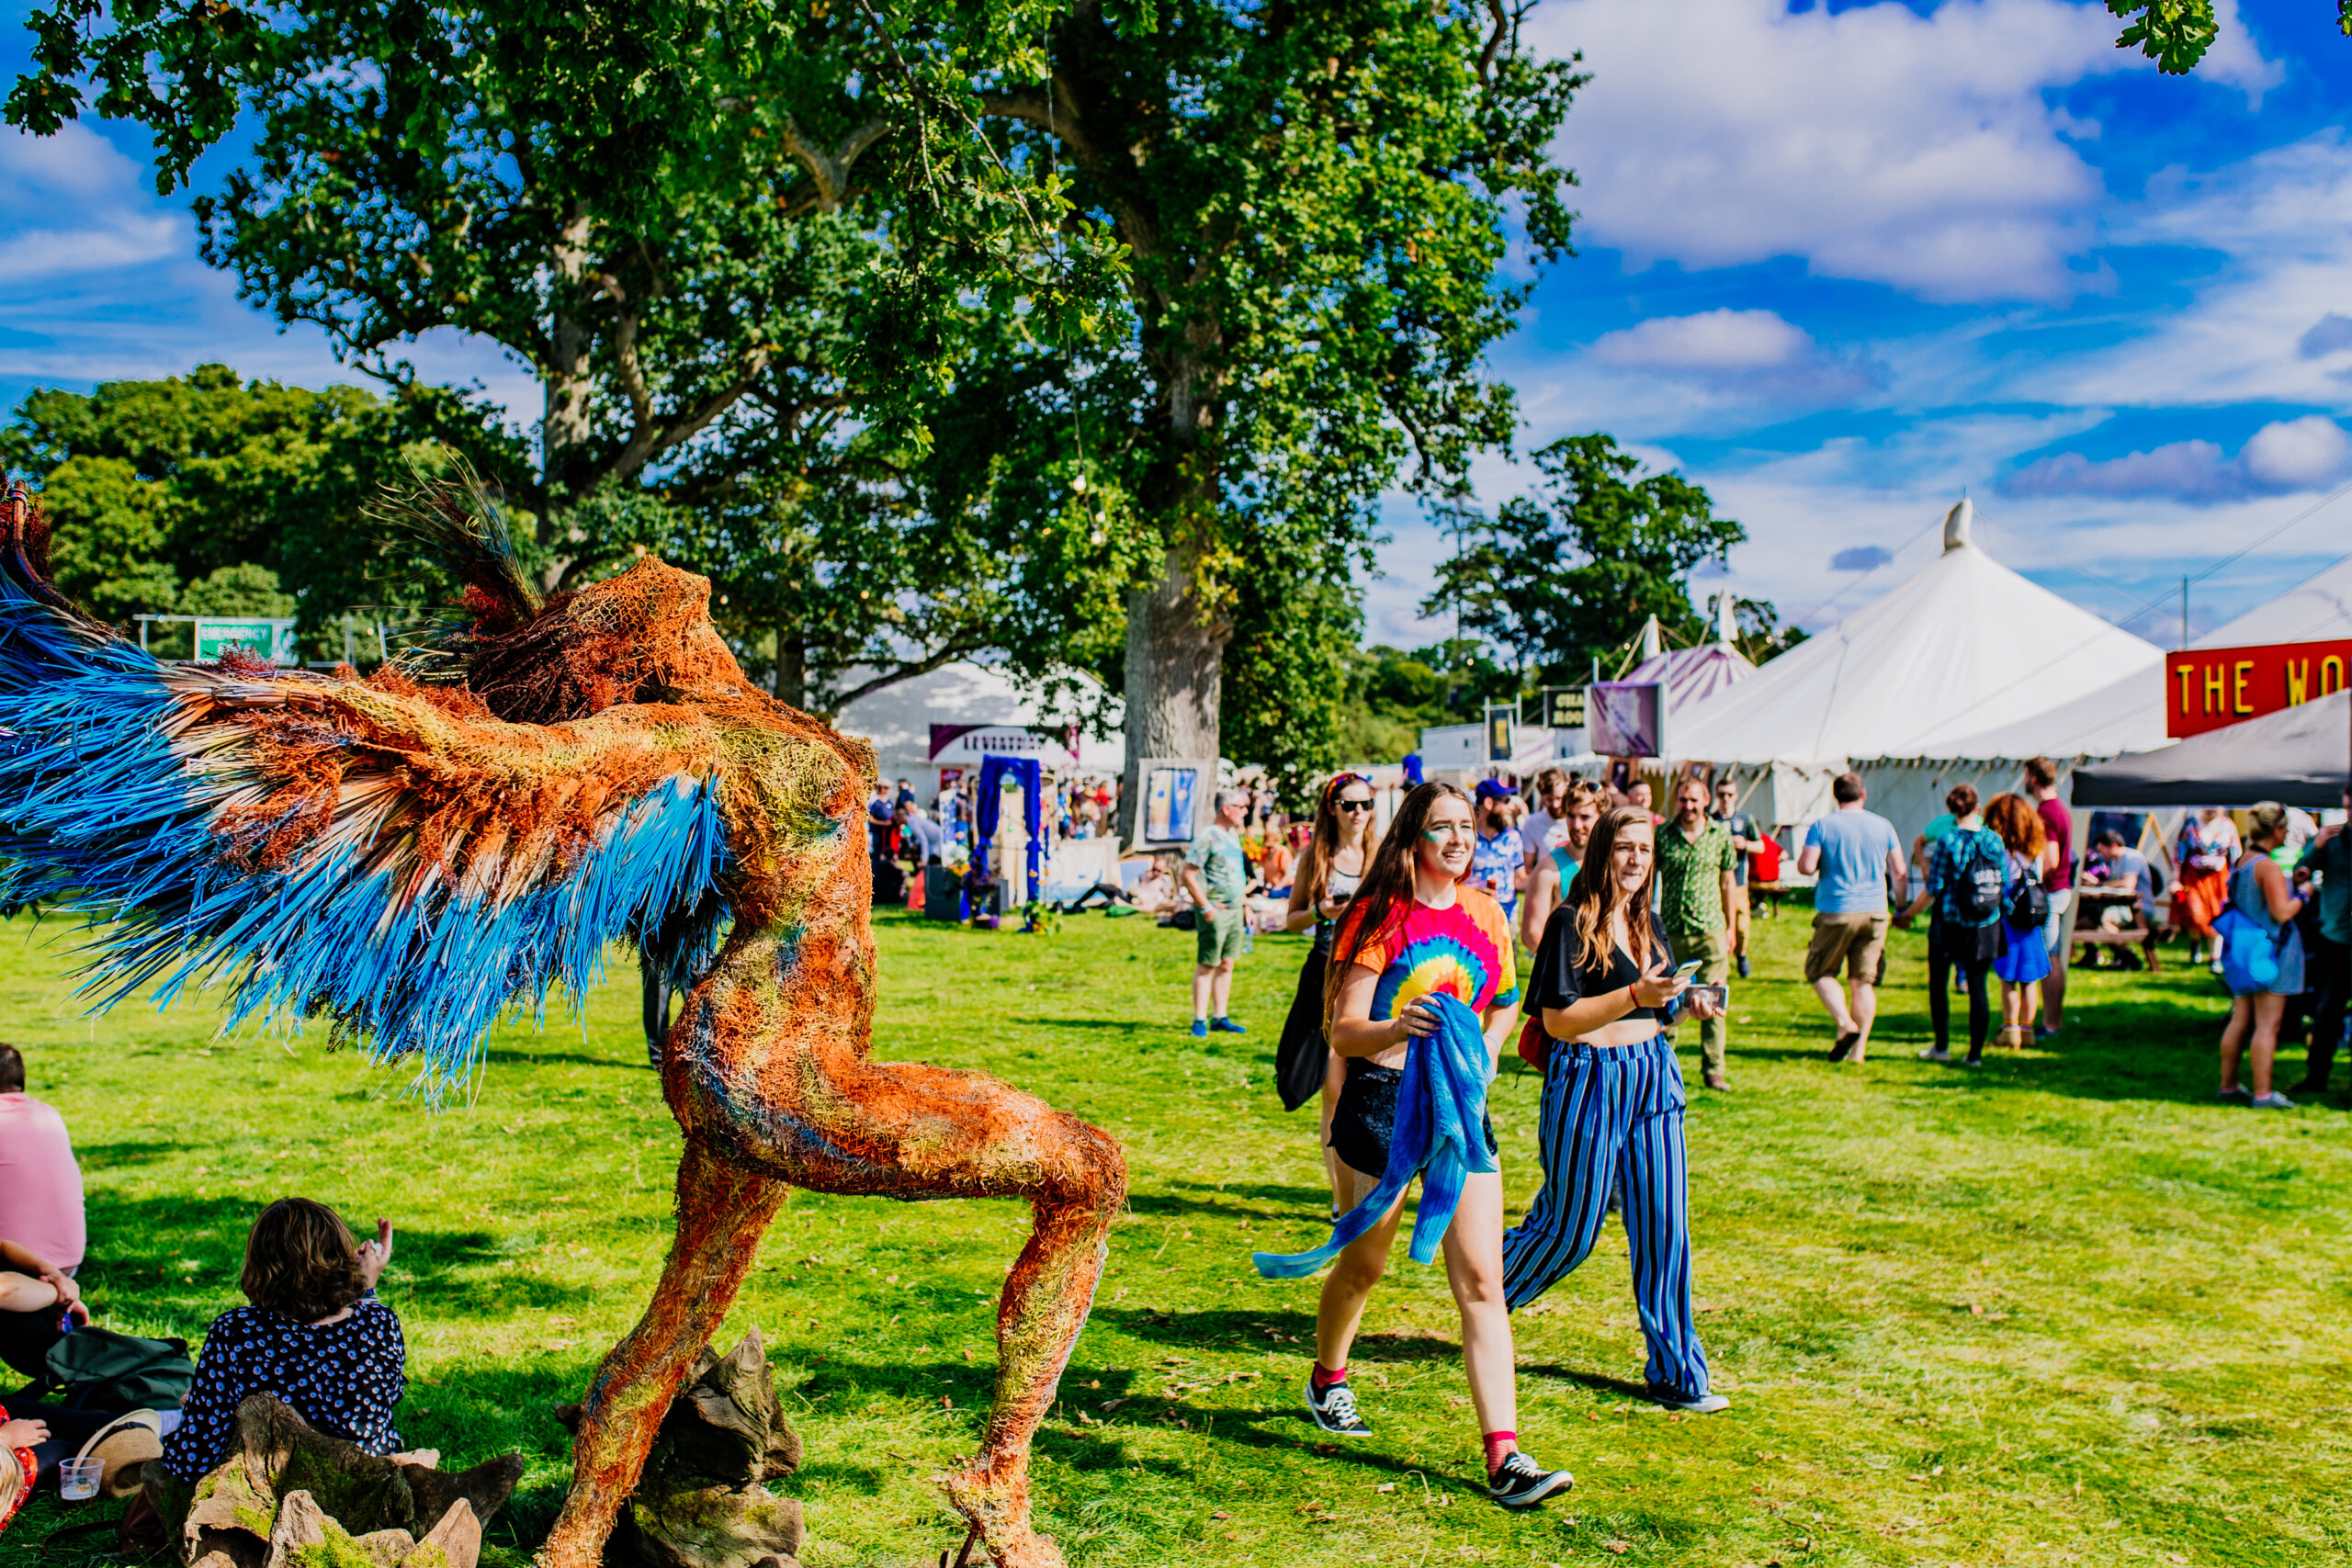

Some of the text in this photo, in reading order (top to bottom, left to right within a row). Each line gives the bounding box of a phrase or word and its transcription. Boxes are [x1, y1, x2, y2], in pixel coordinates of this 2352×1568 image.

[201, 626, 268, 640] EMERGENCY
[2177, 660, 2255, 714] THE
[1553, 710, 1584, 725] ROO
